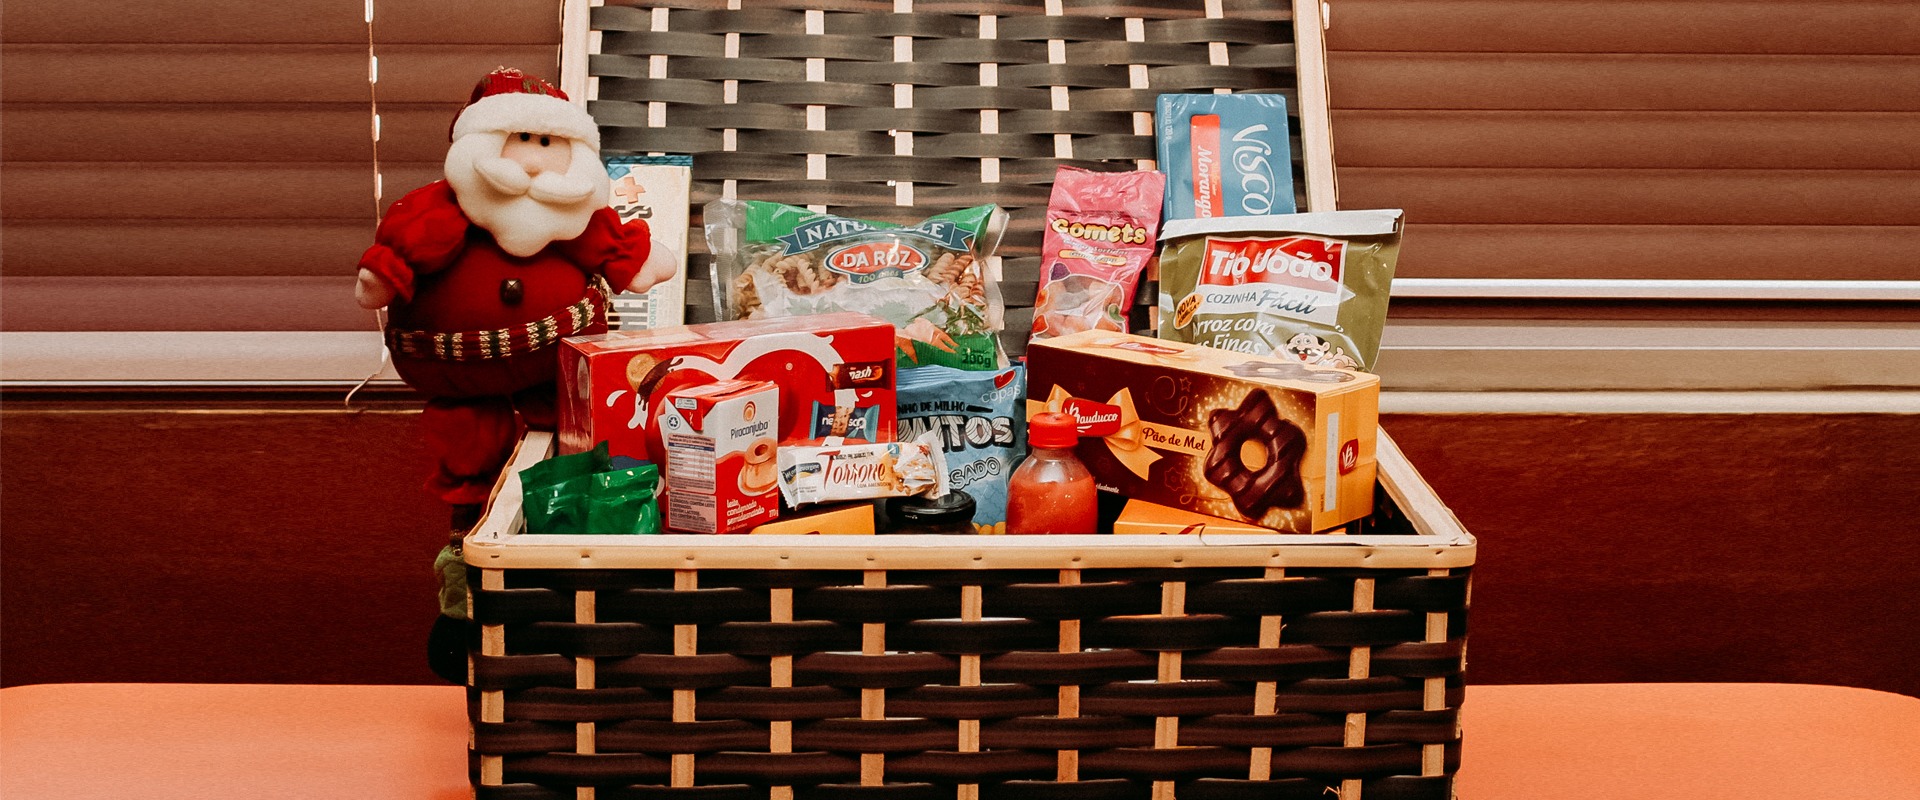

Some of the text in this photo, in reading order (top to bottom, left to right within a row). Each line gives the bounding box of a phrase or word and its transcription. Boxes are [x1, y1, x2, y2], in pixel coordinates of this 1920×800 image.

[1195, 145, 1213, 218] Morango
[1051, 218, 1147, 245] Gomets
[843, 251, 911, 268] DA ROZ
[1210, 248, 1333, 281] Tio João
[857, 273, 875, 284] 100
[649, 298, 657, 327] OOKIES
[1206, 289, 1318, 314] COZINHA Fácil
[1234, 318, 1276, 336] com
[1212, 333, 1263, 355] Finas
[962, 353, 991, 368] 200g
[981, 384, 1021, 403] copas
[920, 401, 932, 412] DE
[934, 400, 966, 412] MILHO
[1064, 402, 1119, 425] Bauducco
[1142, 427, 1206, 450] Pão de Mel
[815, 450, 886, 491] Torrone
[948, 457, 1000, 489] SADO
